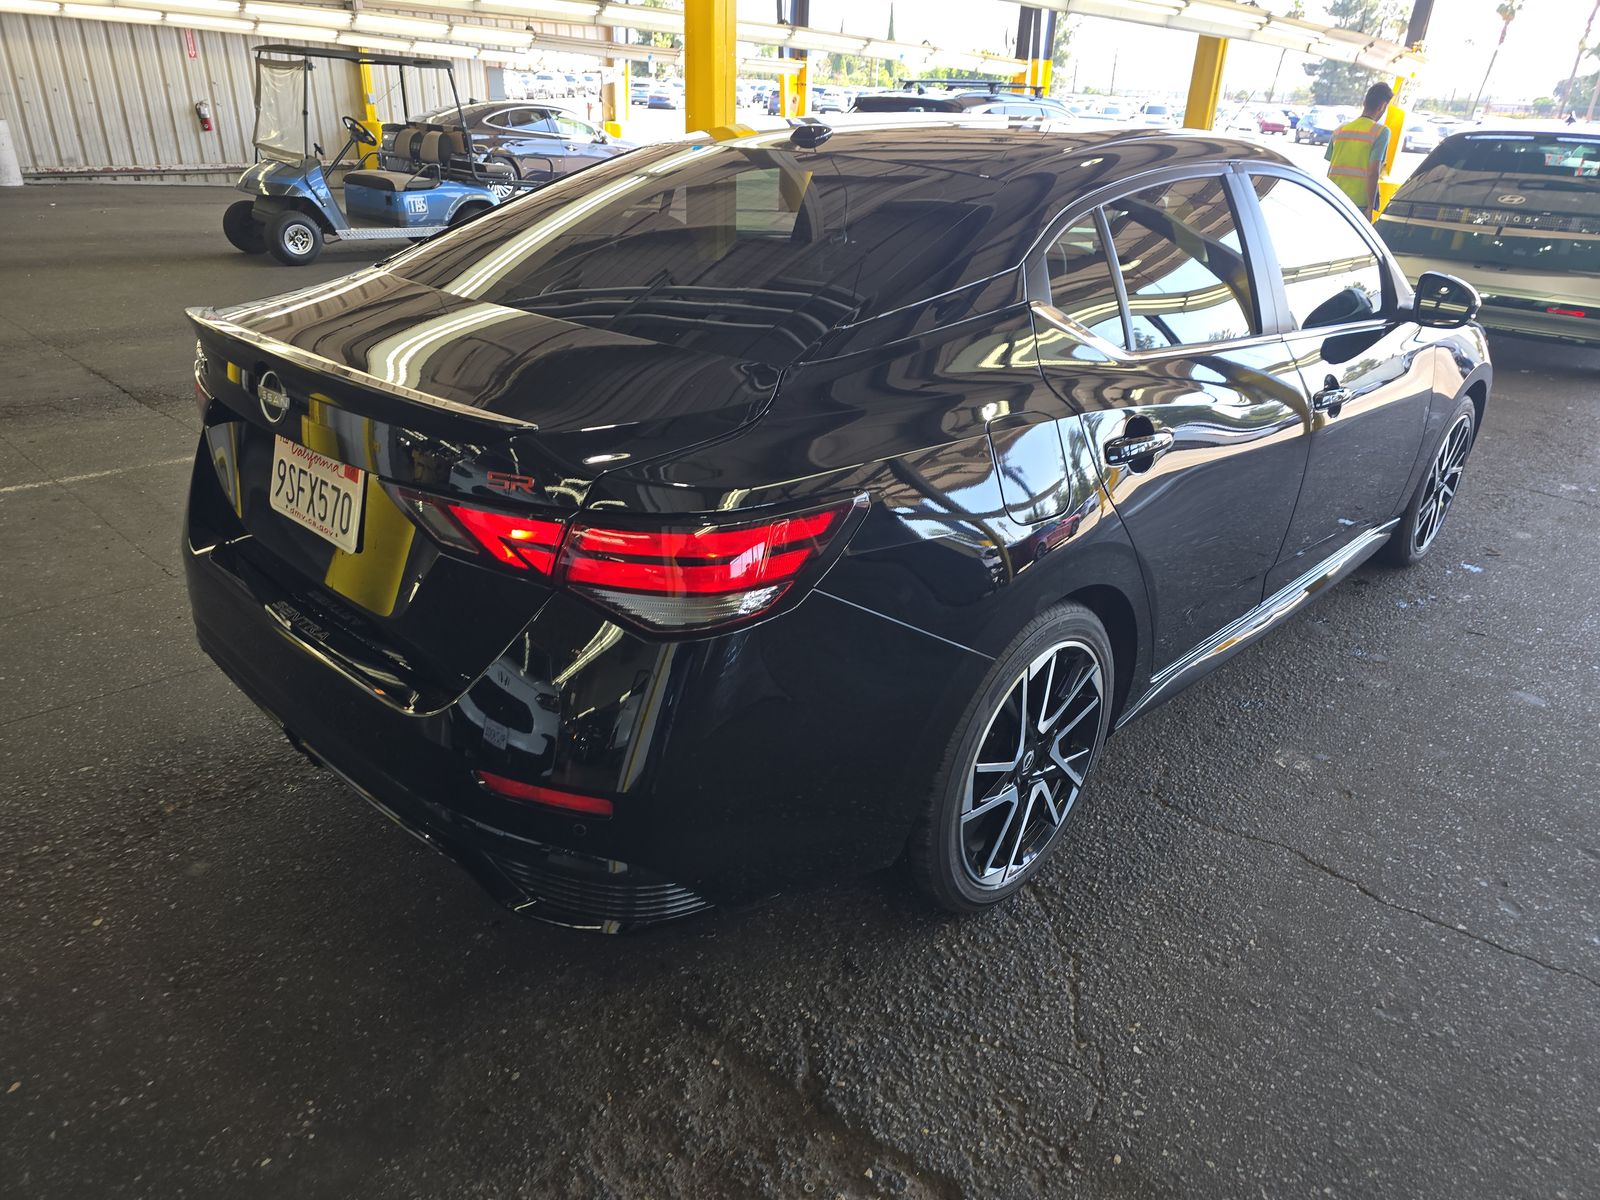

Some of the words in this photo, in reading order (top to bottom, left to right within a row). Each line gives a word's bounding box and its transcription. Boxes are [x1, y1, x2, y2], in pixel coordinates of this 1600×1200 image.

[258, 387, 290, 410] SSAN
[275, 458, 353, 535] 9SFX570
[289, 507, 333, 537] dmv.ca.gov
[271, 600, 330, 642] SENTRA
